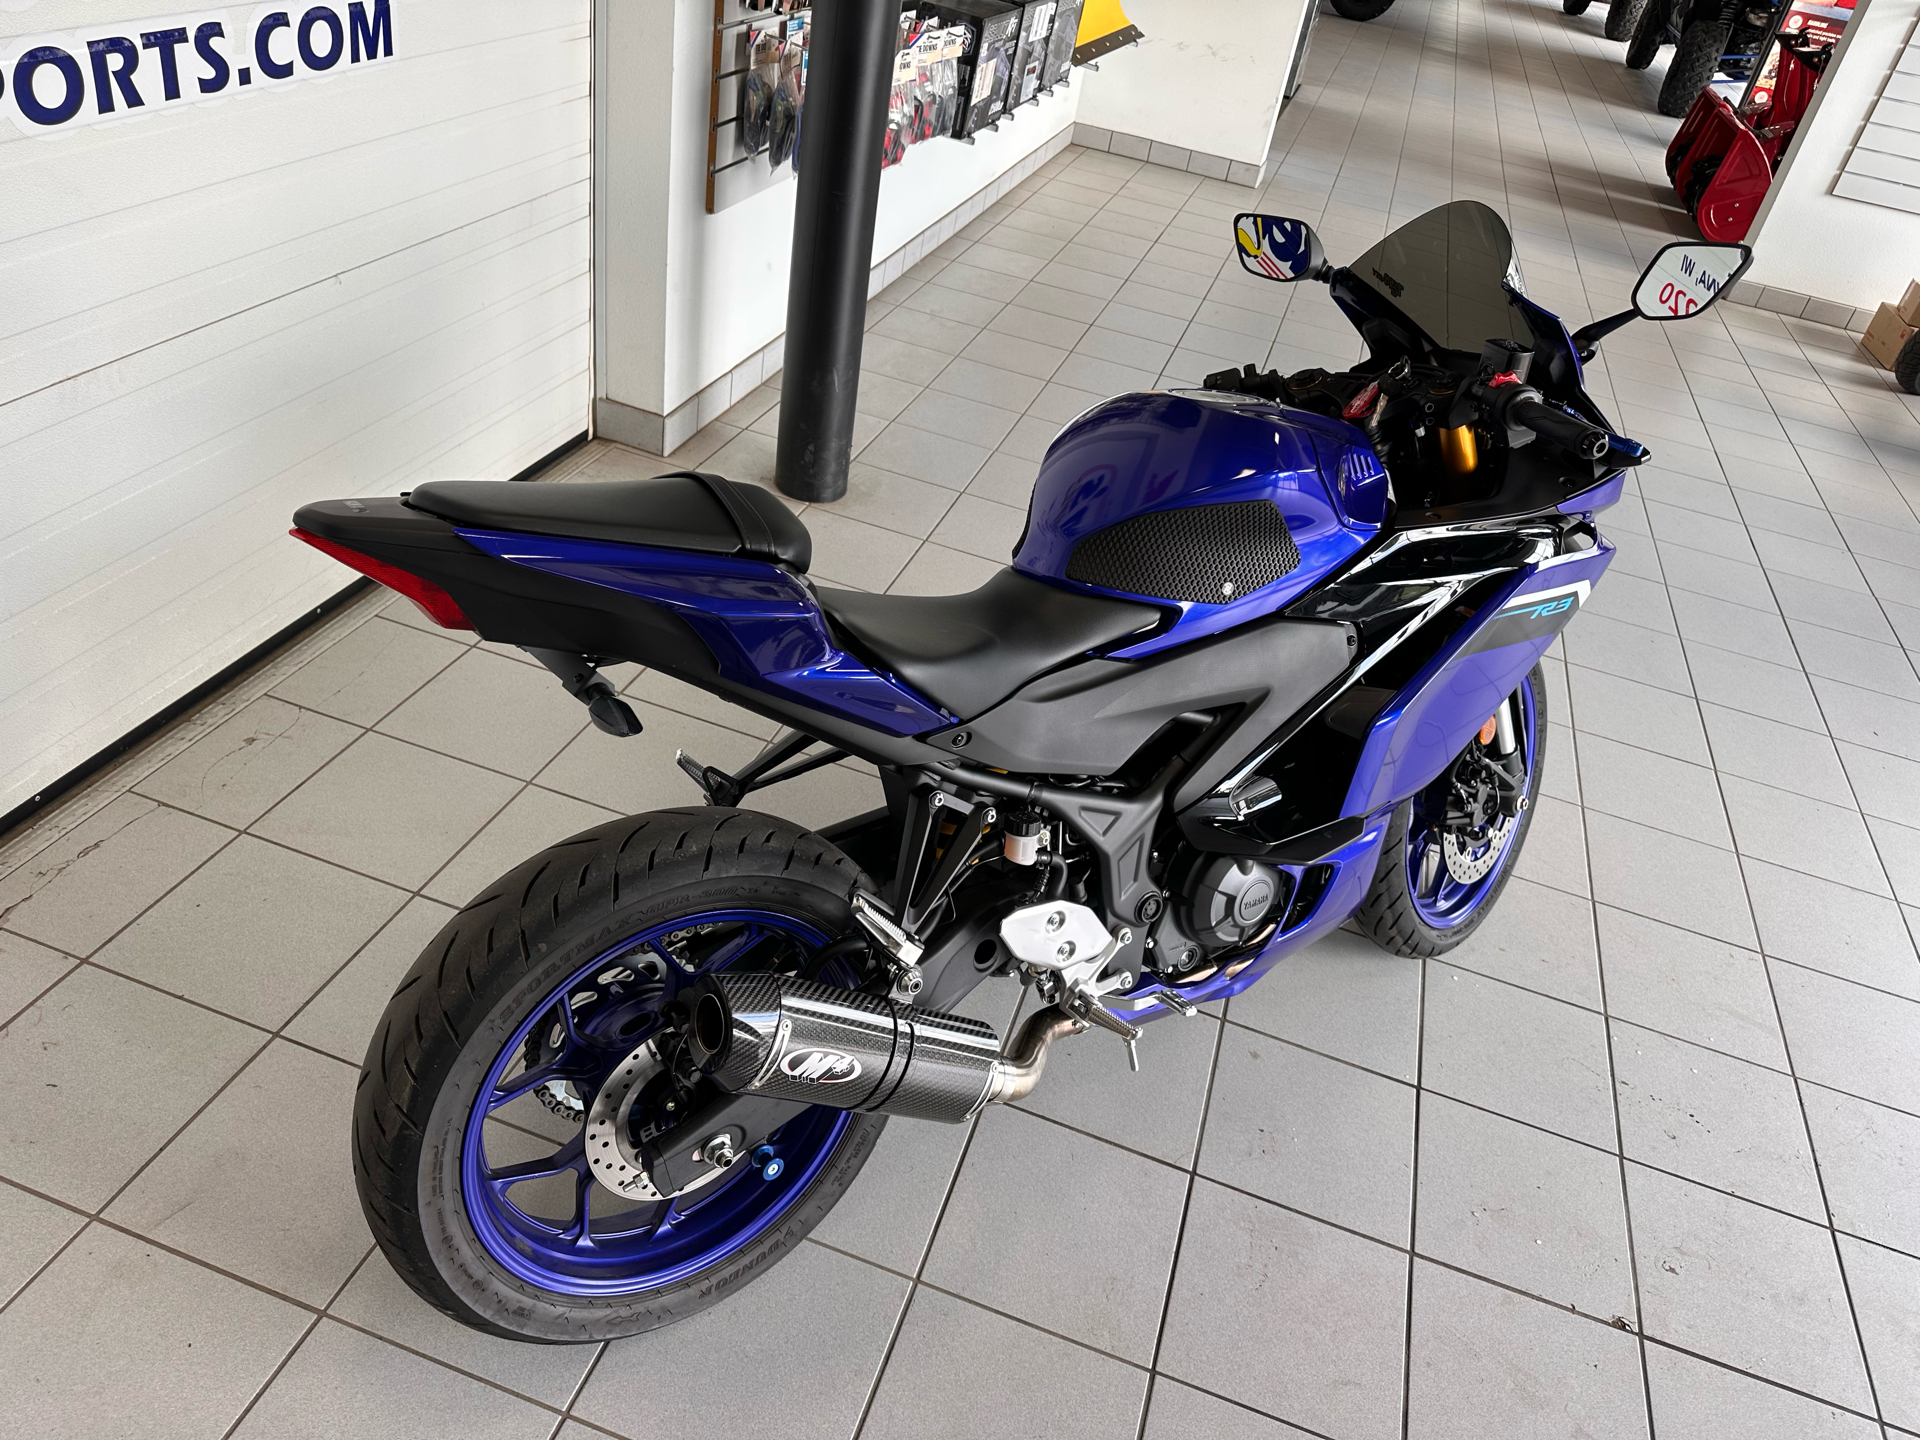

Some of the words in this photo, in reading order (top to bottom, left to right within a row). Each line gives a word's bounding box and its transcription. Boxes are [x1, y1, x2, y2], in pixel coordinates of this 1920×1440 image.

[0, 0, 393, 126] ORTS.COM
[923, 43, 938, 52] DOWNS
[1520, 597, 1575, 619] R3
[1243, 894, 1269, 910] YAMAHA
[500, 912, 634, 1025] SPORTMAX
[698, 1238, 781, 1300] DUNLOP
